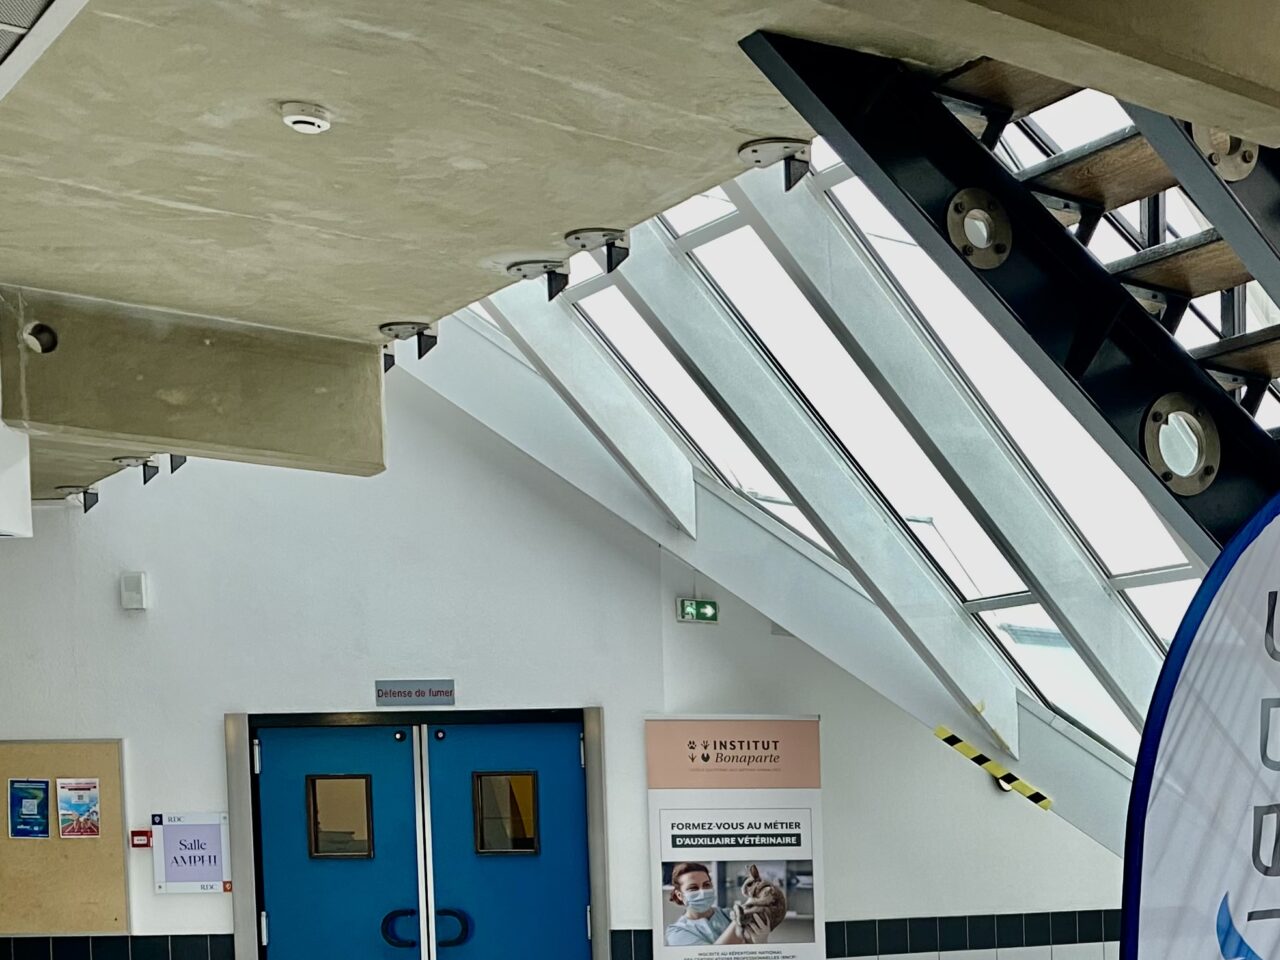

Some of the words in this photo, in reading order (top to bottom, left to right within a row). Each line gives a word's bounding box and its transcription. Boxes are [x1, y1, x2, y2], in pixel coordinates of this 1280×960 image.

[377, 688, 413, 698] Défense
[415, 688, 426, 698] de
[428, 687, 453, 698] fumer
[713, 740, 780, 751] INSTITUT
[715, 752, 780, 766] Bonaparte
[671, 821, 744, 831] FORMEZ-VOUS
[746, 821, 761, 831] AU
[764, 819, 801, 830] MÉTIER
[178, 838, 207, 851] Salle
[676, 836, 736, 846] D'AUXILIAIRE
[738, 834, 797, 845] VÉTÉRINAIRE
[170, 854, 217, 867] AMPHI
